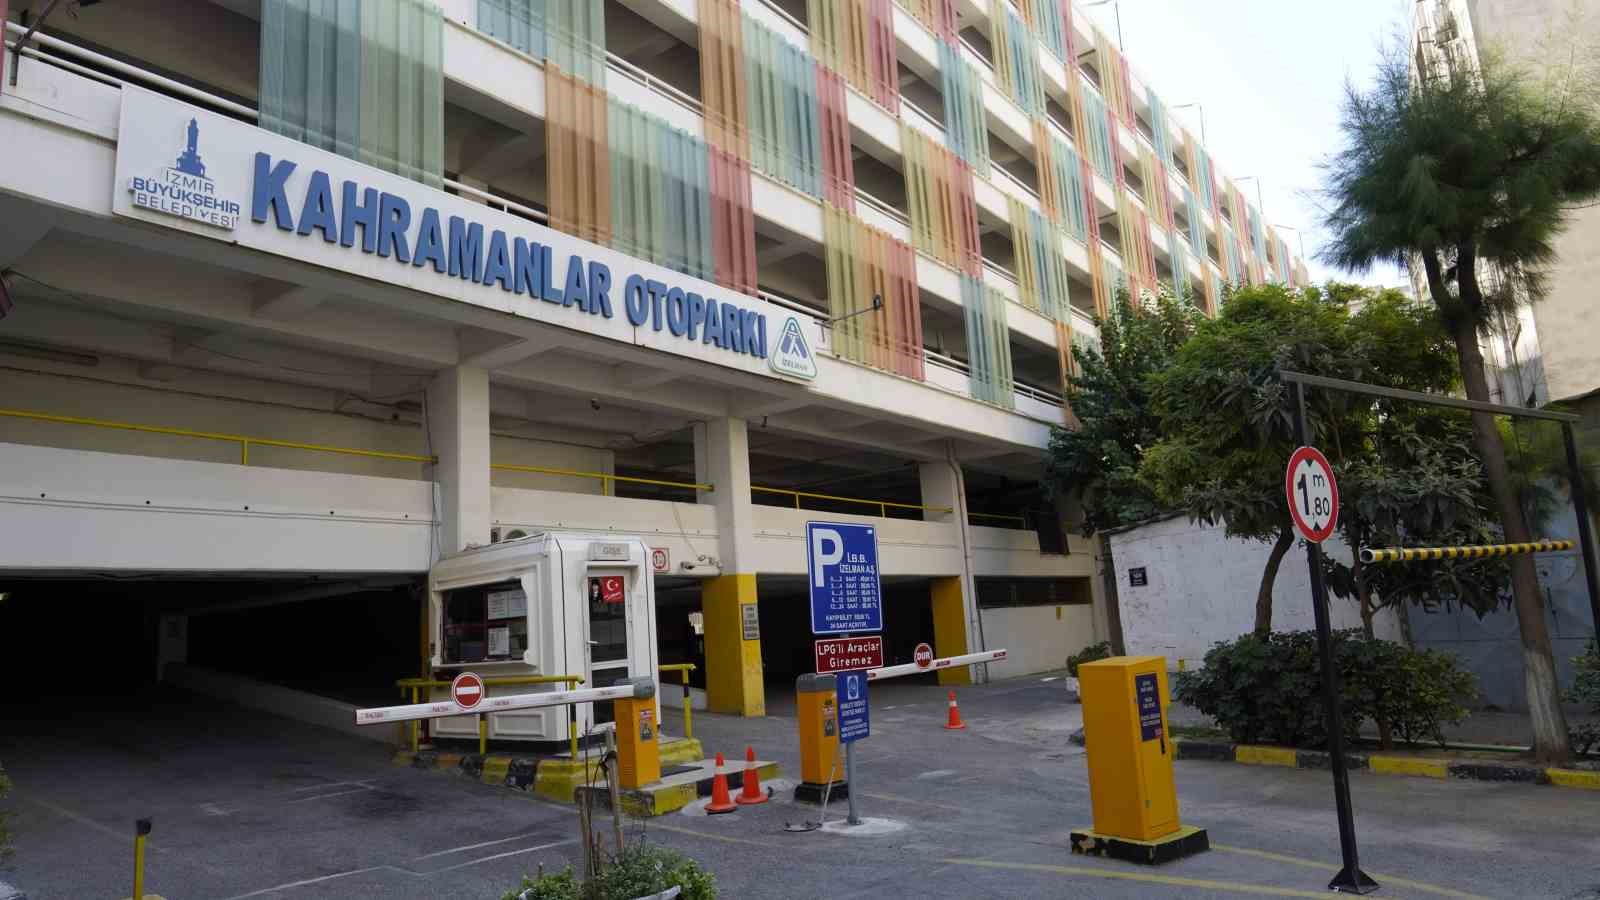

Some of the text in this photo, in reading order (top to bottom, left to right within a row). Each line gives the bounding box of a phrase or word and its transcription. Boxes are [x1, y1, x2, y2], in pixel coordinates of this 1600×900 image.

[133, 176, 240, 216] BÜYÜKŞEHİR
[251, 152, 768, 359] KAHRAMANLAR OTOPARKI
[1297, 473, 1310, 516] 1
[812, 528, 844, 588] P
[829, 656, 873, 668] Giremez
[848, 641, 880, 653] Araçlar
[916, 651, 931, 661] DUR
